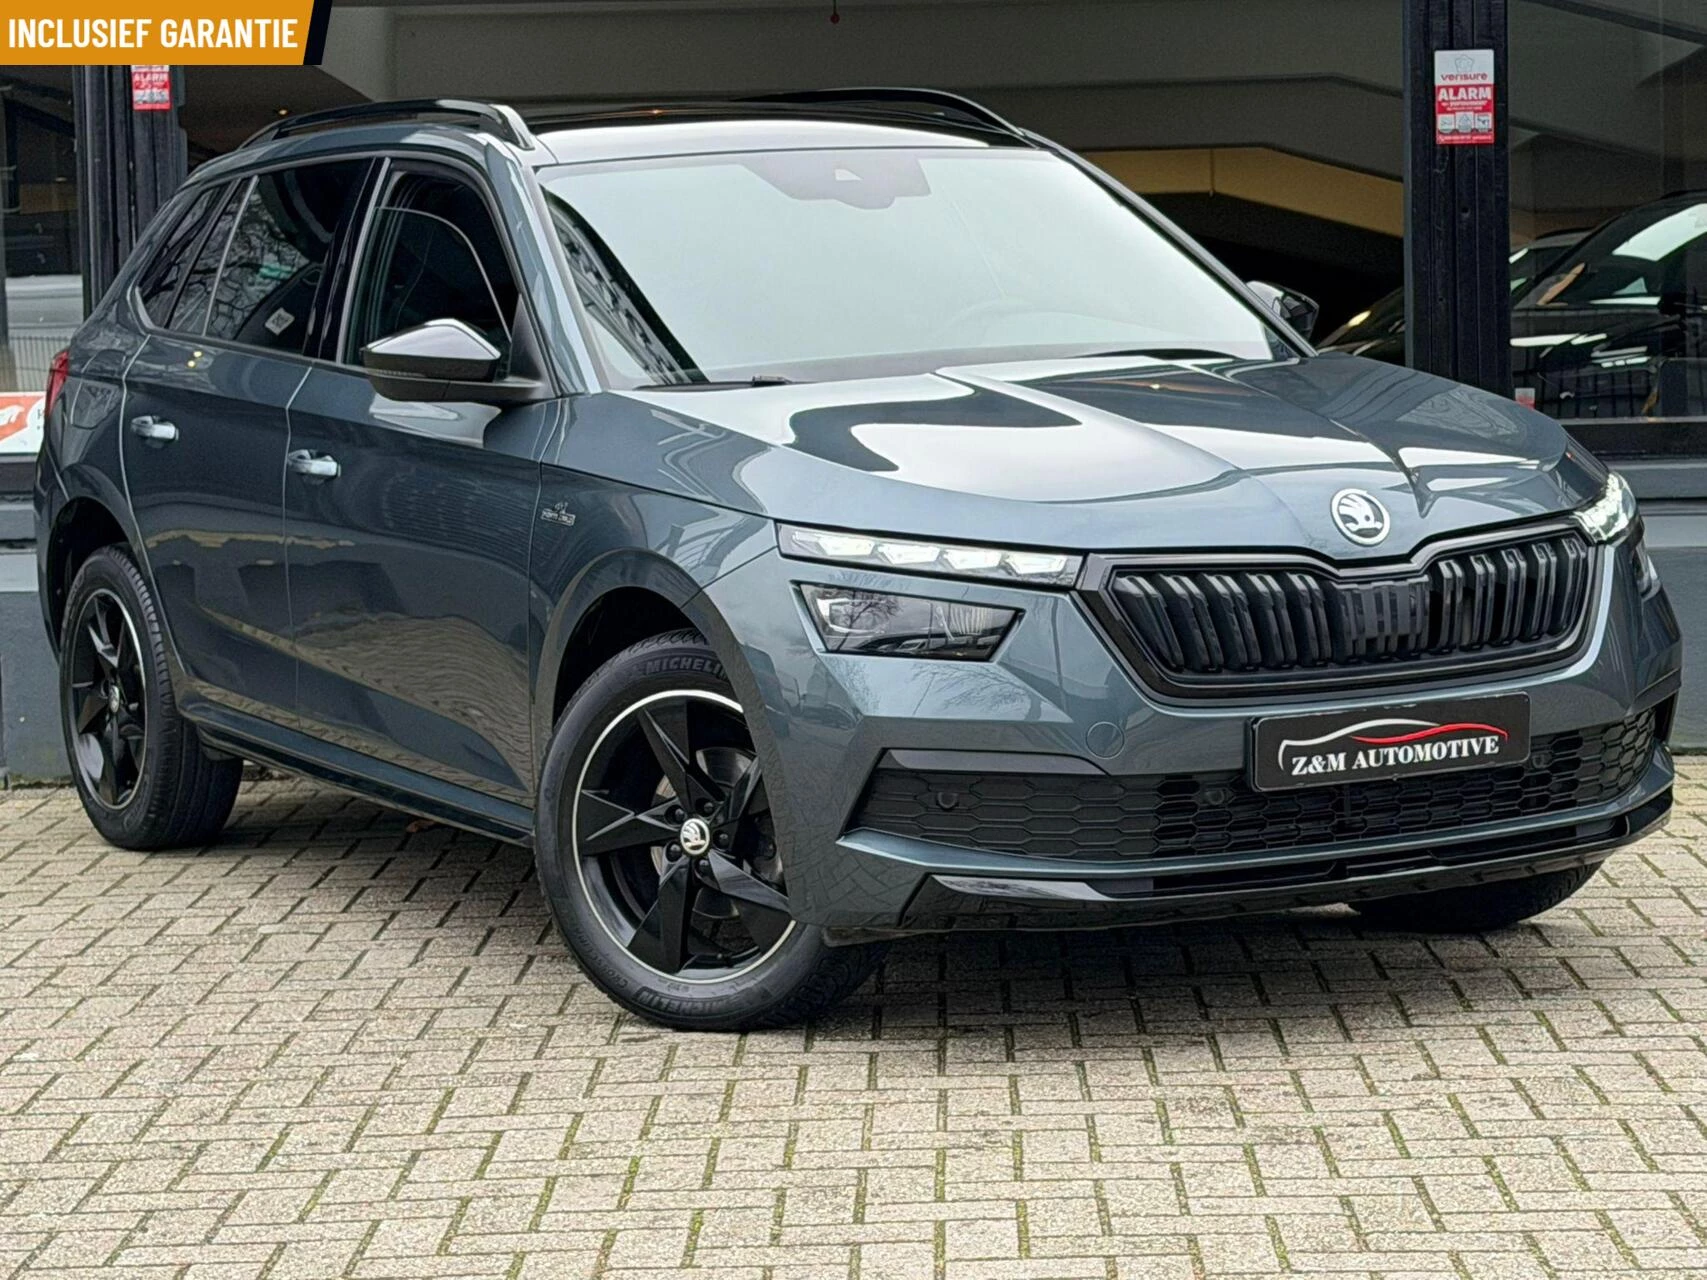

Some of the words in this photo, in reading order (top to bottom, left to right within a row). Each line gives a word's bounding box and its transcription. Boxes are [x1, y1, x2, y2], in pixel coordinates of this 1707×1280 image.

[1441, 72, 1488, 81] verisure
[1439, 87, 1492, 101] ALARM
[1291, 752, 1347, 776] Z&M
[1352, 735, 1499, 770] AUTOMOTIVE
